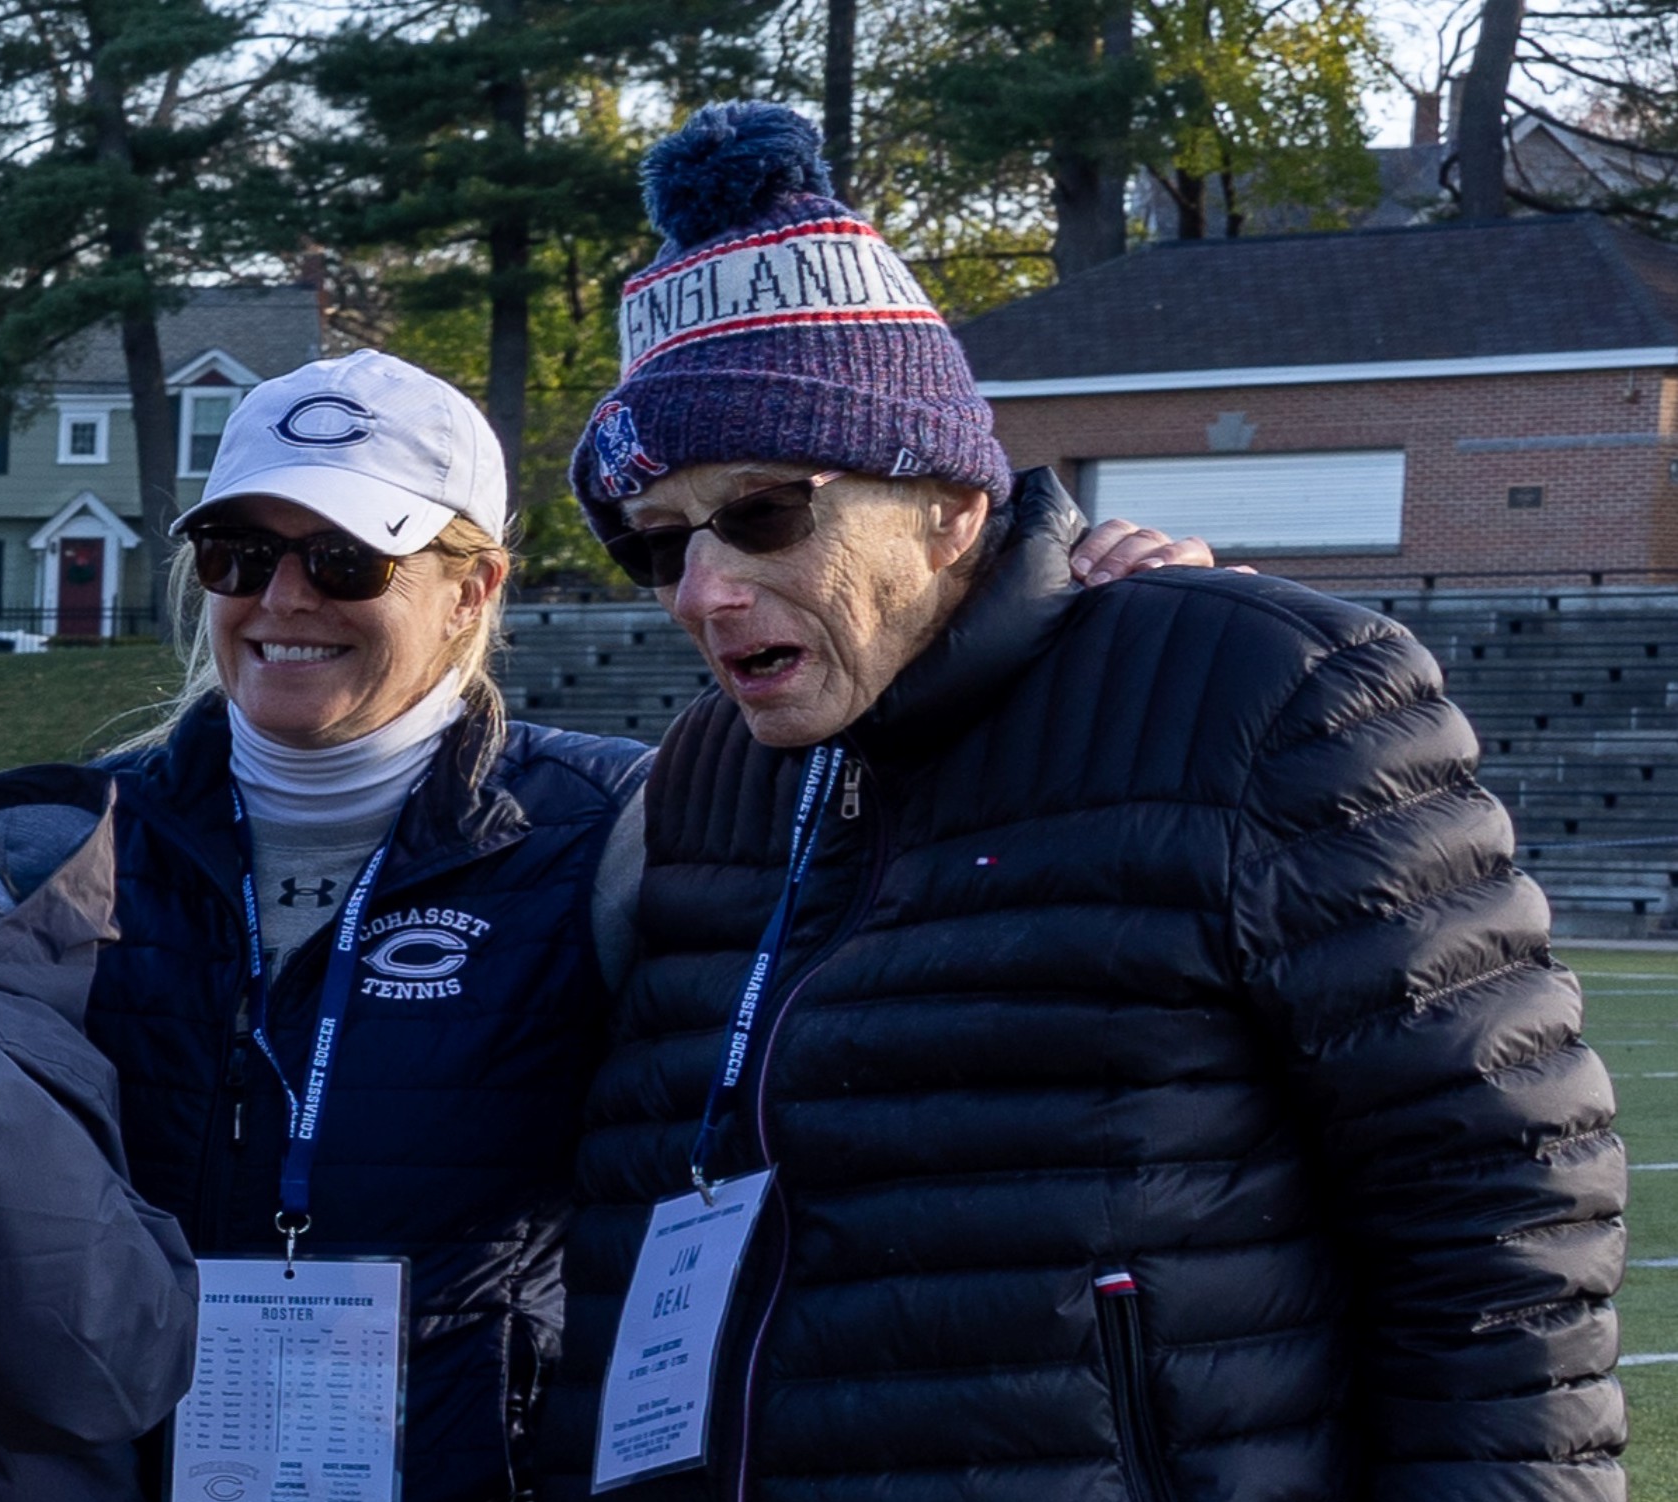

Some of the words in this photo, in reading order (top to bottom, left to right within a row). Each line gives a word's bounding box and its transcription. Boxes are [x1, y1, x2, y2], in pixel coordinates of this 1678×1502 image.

[624, 240, 871, 356] ENGLAND
[358, 907, 490, 942] COHASSET
[362, 977, 462, 1000] TENNIS
[736, 952, 770, 1031] COHASSET
[723, 1031, 749, 1088] SOCCER
[298, 1068, 326, 1139] COHASSET
[312, 1017, 337, 1068] SOCCER
[669, 1244, 702, 1277] JIM
[262, 1307, 314, 1321] ROSTER
[652, 1283, 690, 1319] BEAL
